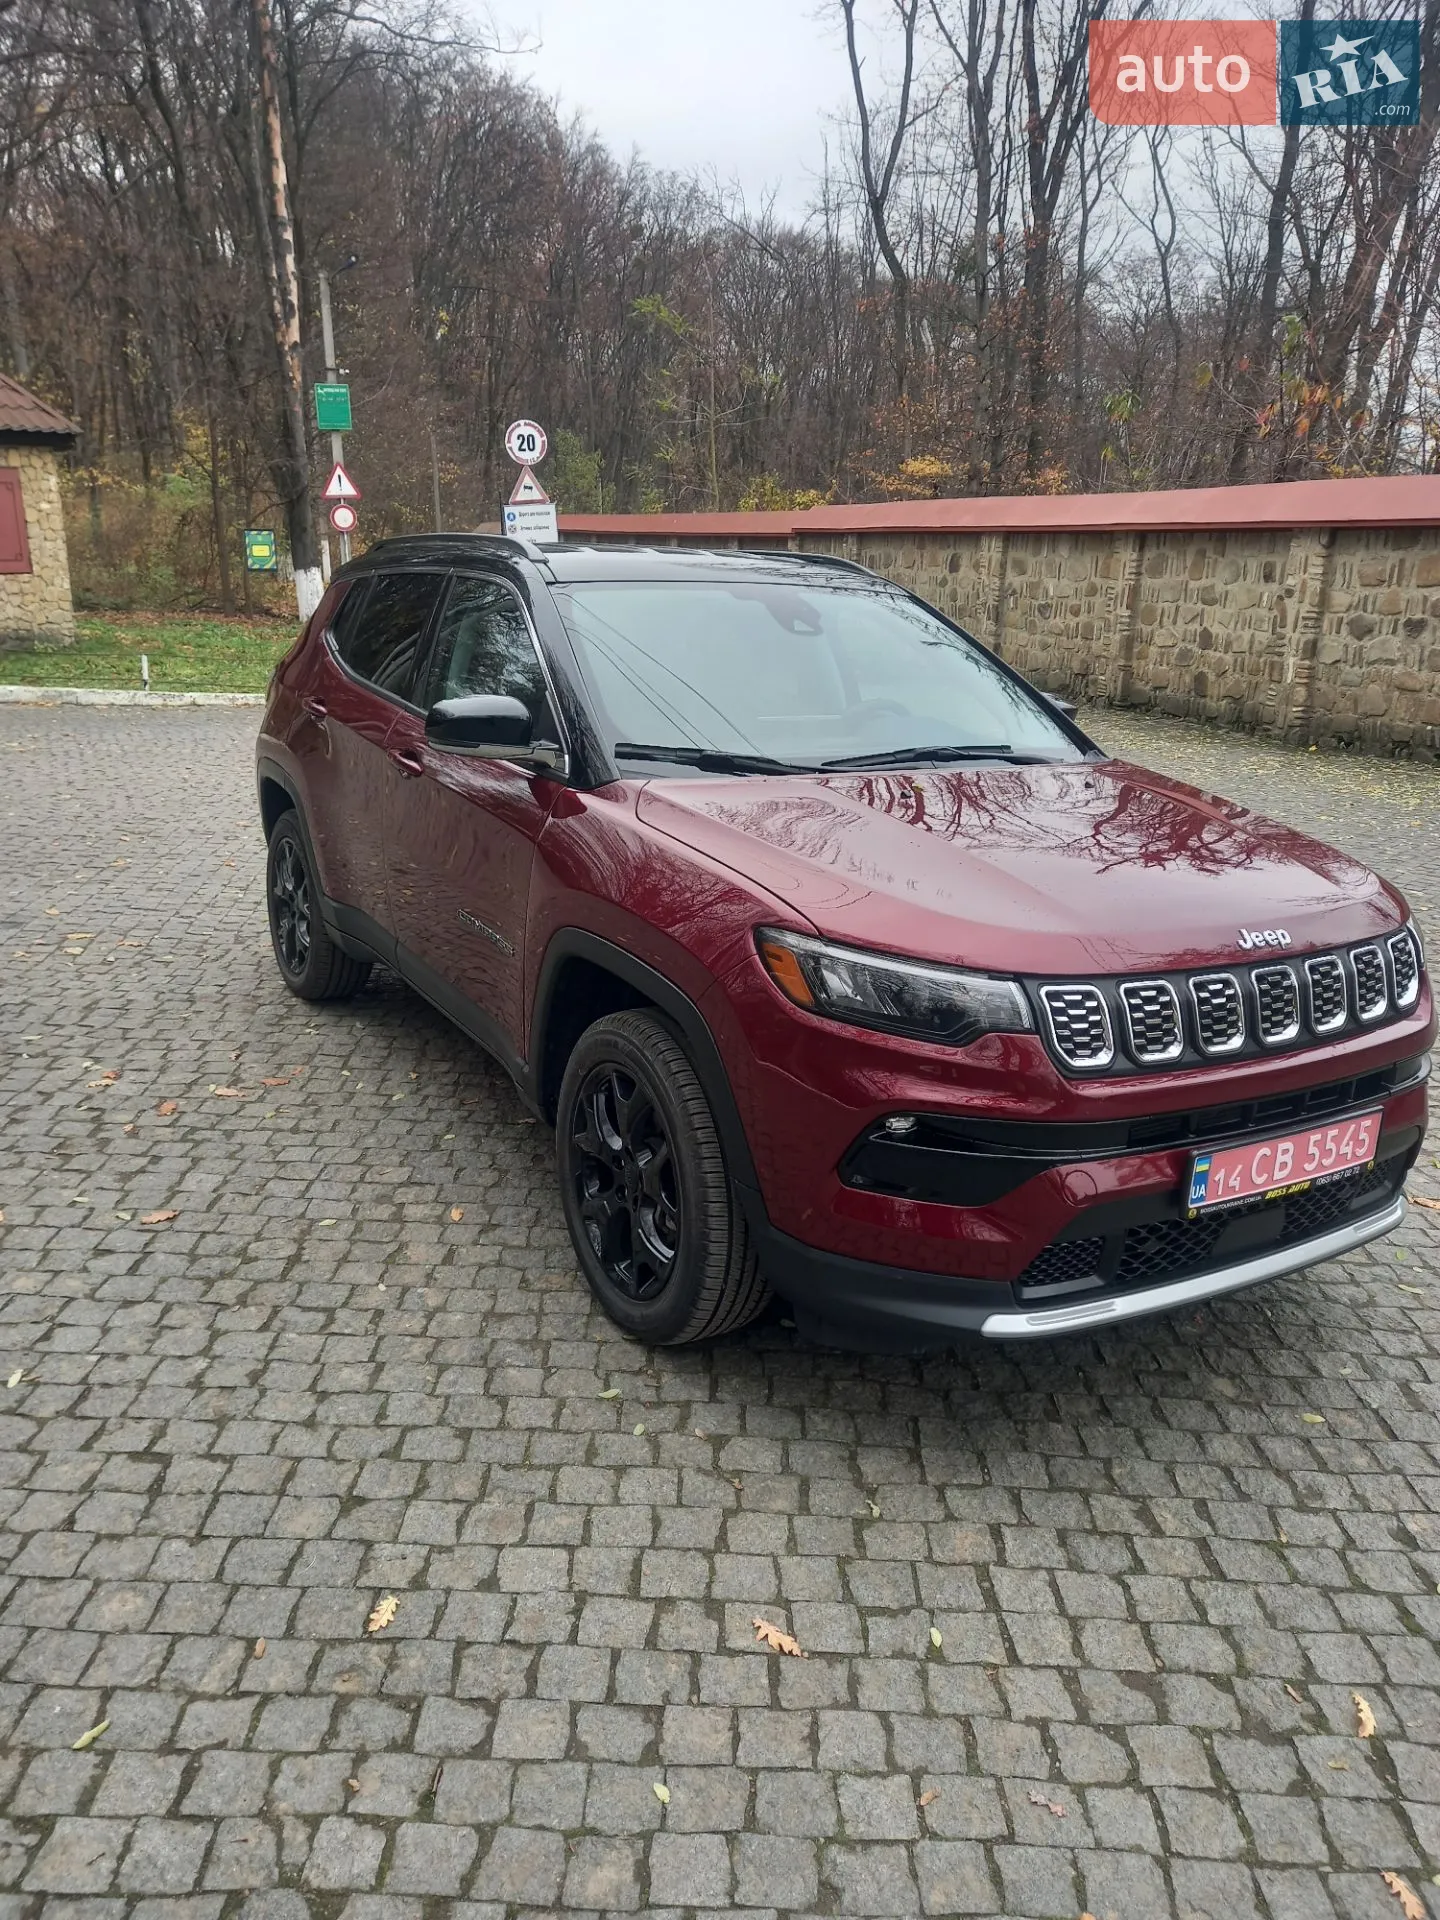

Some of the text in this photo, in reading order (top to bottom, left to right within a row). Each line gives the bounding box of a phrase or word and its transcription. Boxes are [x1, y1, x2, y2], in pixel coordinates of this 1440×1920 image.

[517, 433, 536, 452] 20
[1237, 928, 1292, 950] Jeep
[1214, 1120, 1372, 1196] 14 CB 5545
[1191, 1183, 1207, 1199] UA
[1265, 1187, 1287, 1200] BOSS
[1287, 1181, 1312, 1194] AUTO
